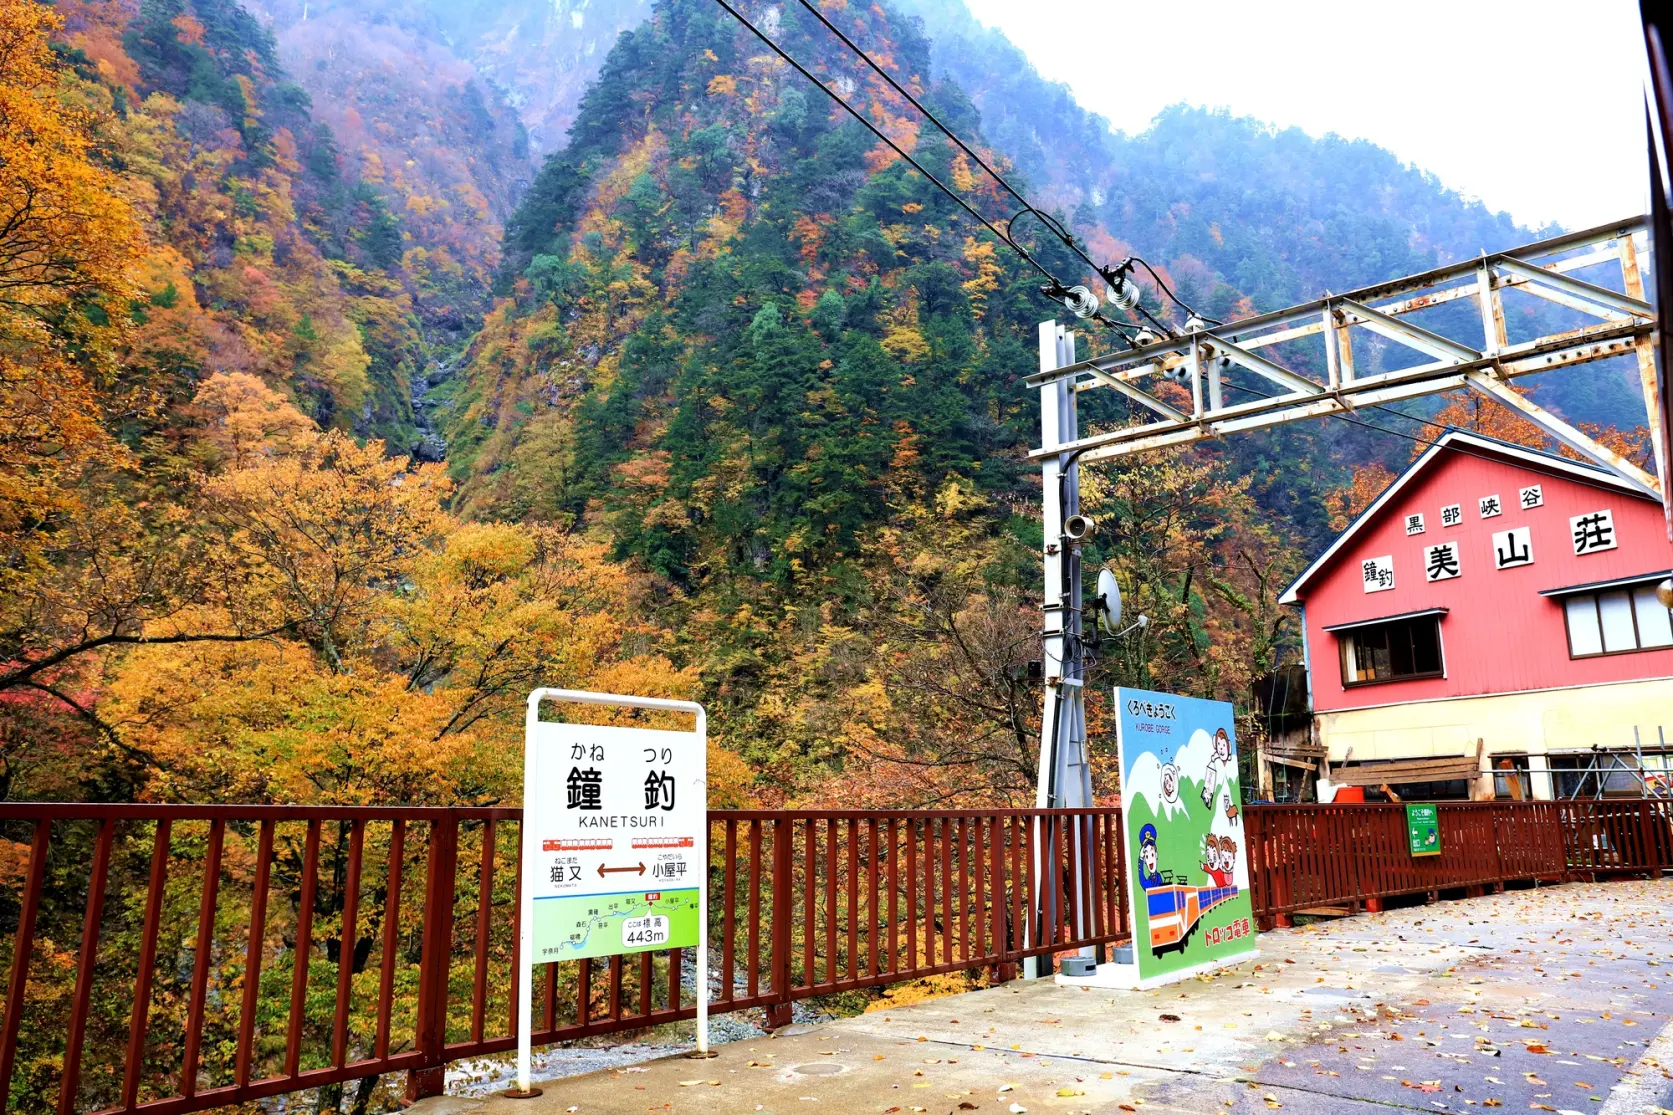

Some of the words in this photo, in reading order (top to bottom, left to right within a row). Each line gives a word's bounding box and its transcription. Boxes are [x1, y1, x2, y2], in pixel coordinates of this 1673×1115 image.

[1407, 487, 1542, 533] 黒部峡谷
[1364, 561, 1394, 588] 鐘釣
[1427, 513, 1613, 580] 美山荘
[1127, 699, 1177, 720] くろべきょうこく
[1135, 722, 1154, 733] KUROBE
[1155, 724, 1171, 735] GORGE
[570, 742, 605, 762] かね
[643, 747, 673, 765] つり
[578, 815, 664, 828] KANETSURI
[554, 856, 578, 865] ねこまた
[657, 853, 683, 861] こやだいら
[550, 865, 582, 883] 猫又
[652, 862, 687, 878] 小屋平
[627, 920, 642, 929] ここは
[1204, 917, 1250, 947] トロッコ電車
[627, 929, 664, 944] 443m
